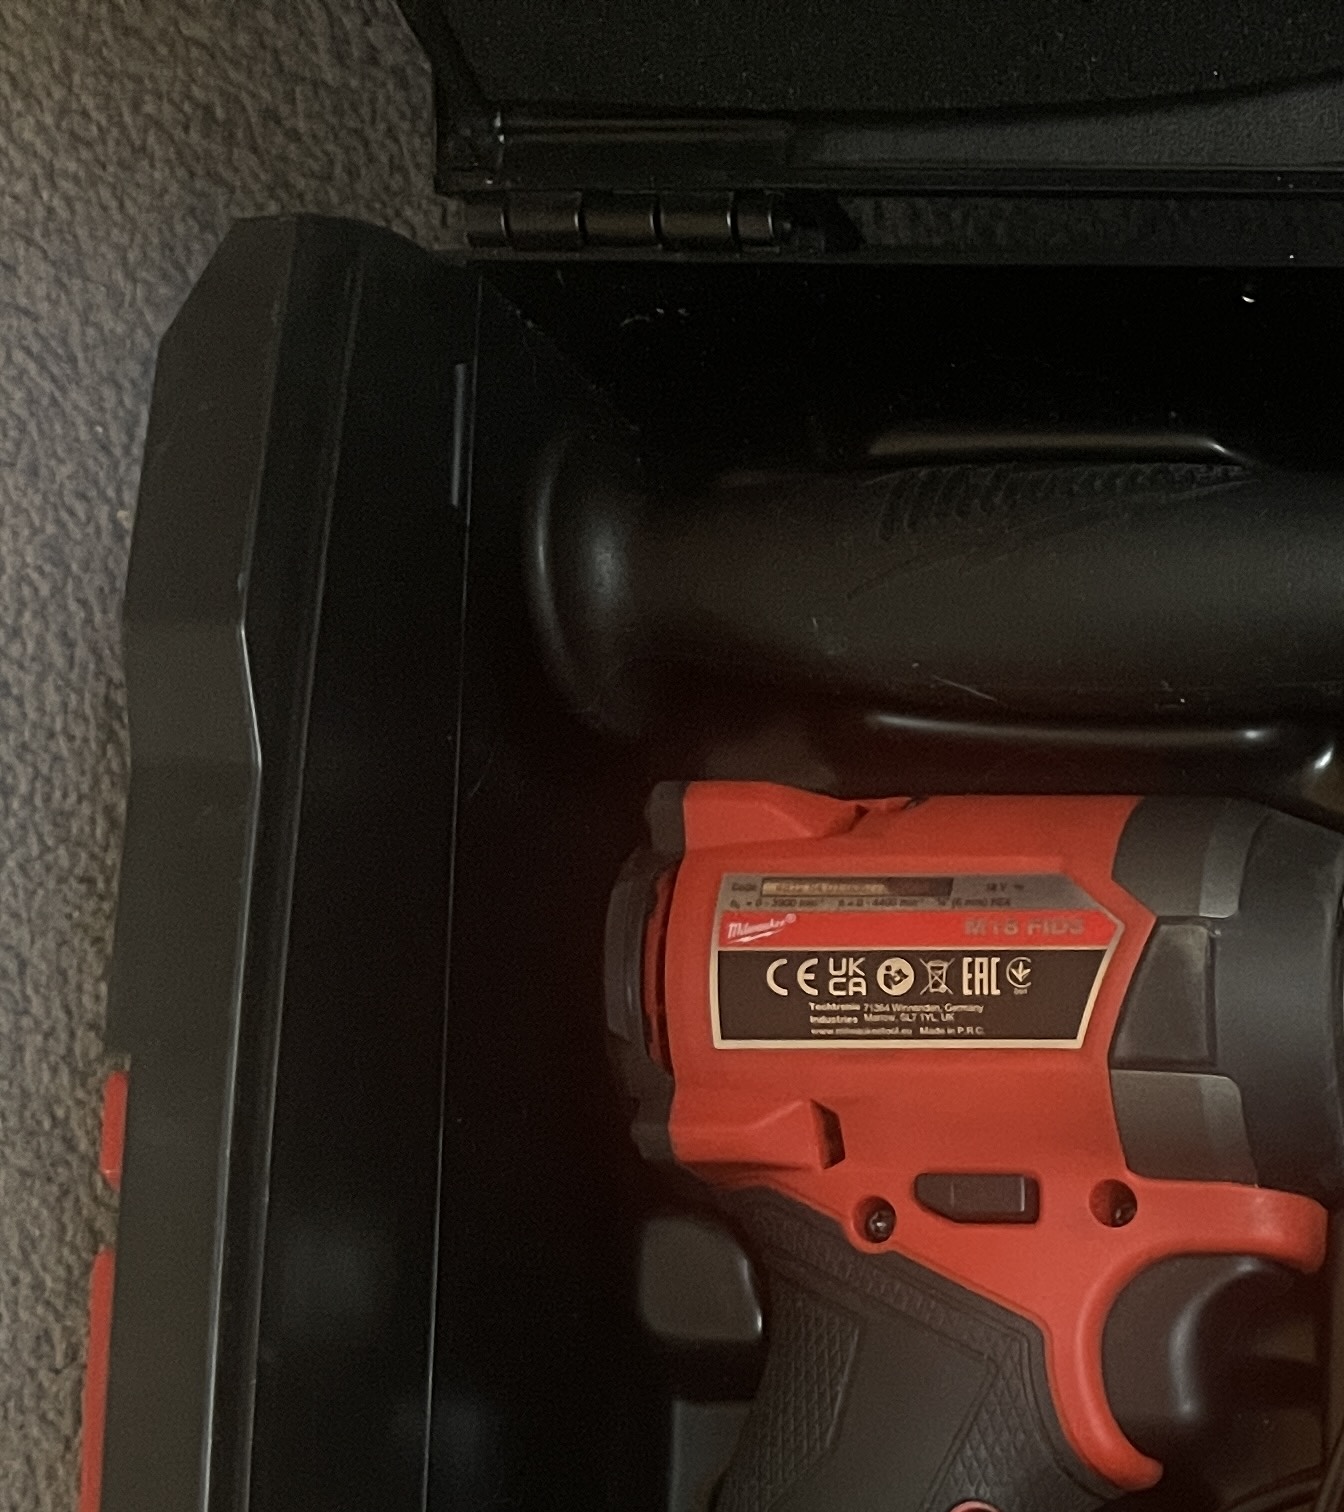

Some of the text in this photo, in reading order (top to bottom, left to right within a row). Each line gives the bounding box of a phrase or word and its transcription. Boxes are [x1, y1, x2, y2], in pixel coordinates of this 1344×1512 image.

[765, 957, 819, 996] CE
[828, 957, 866, 977] UK
[828, 978, 867, 997] CA
